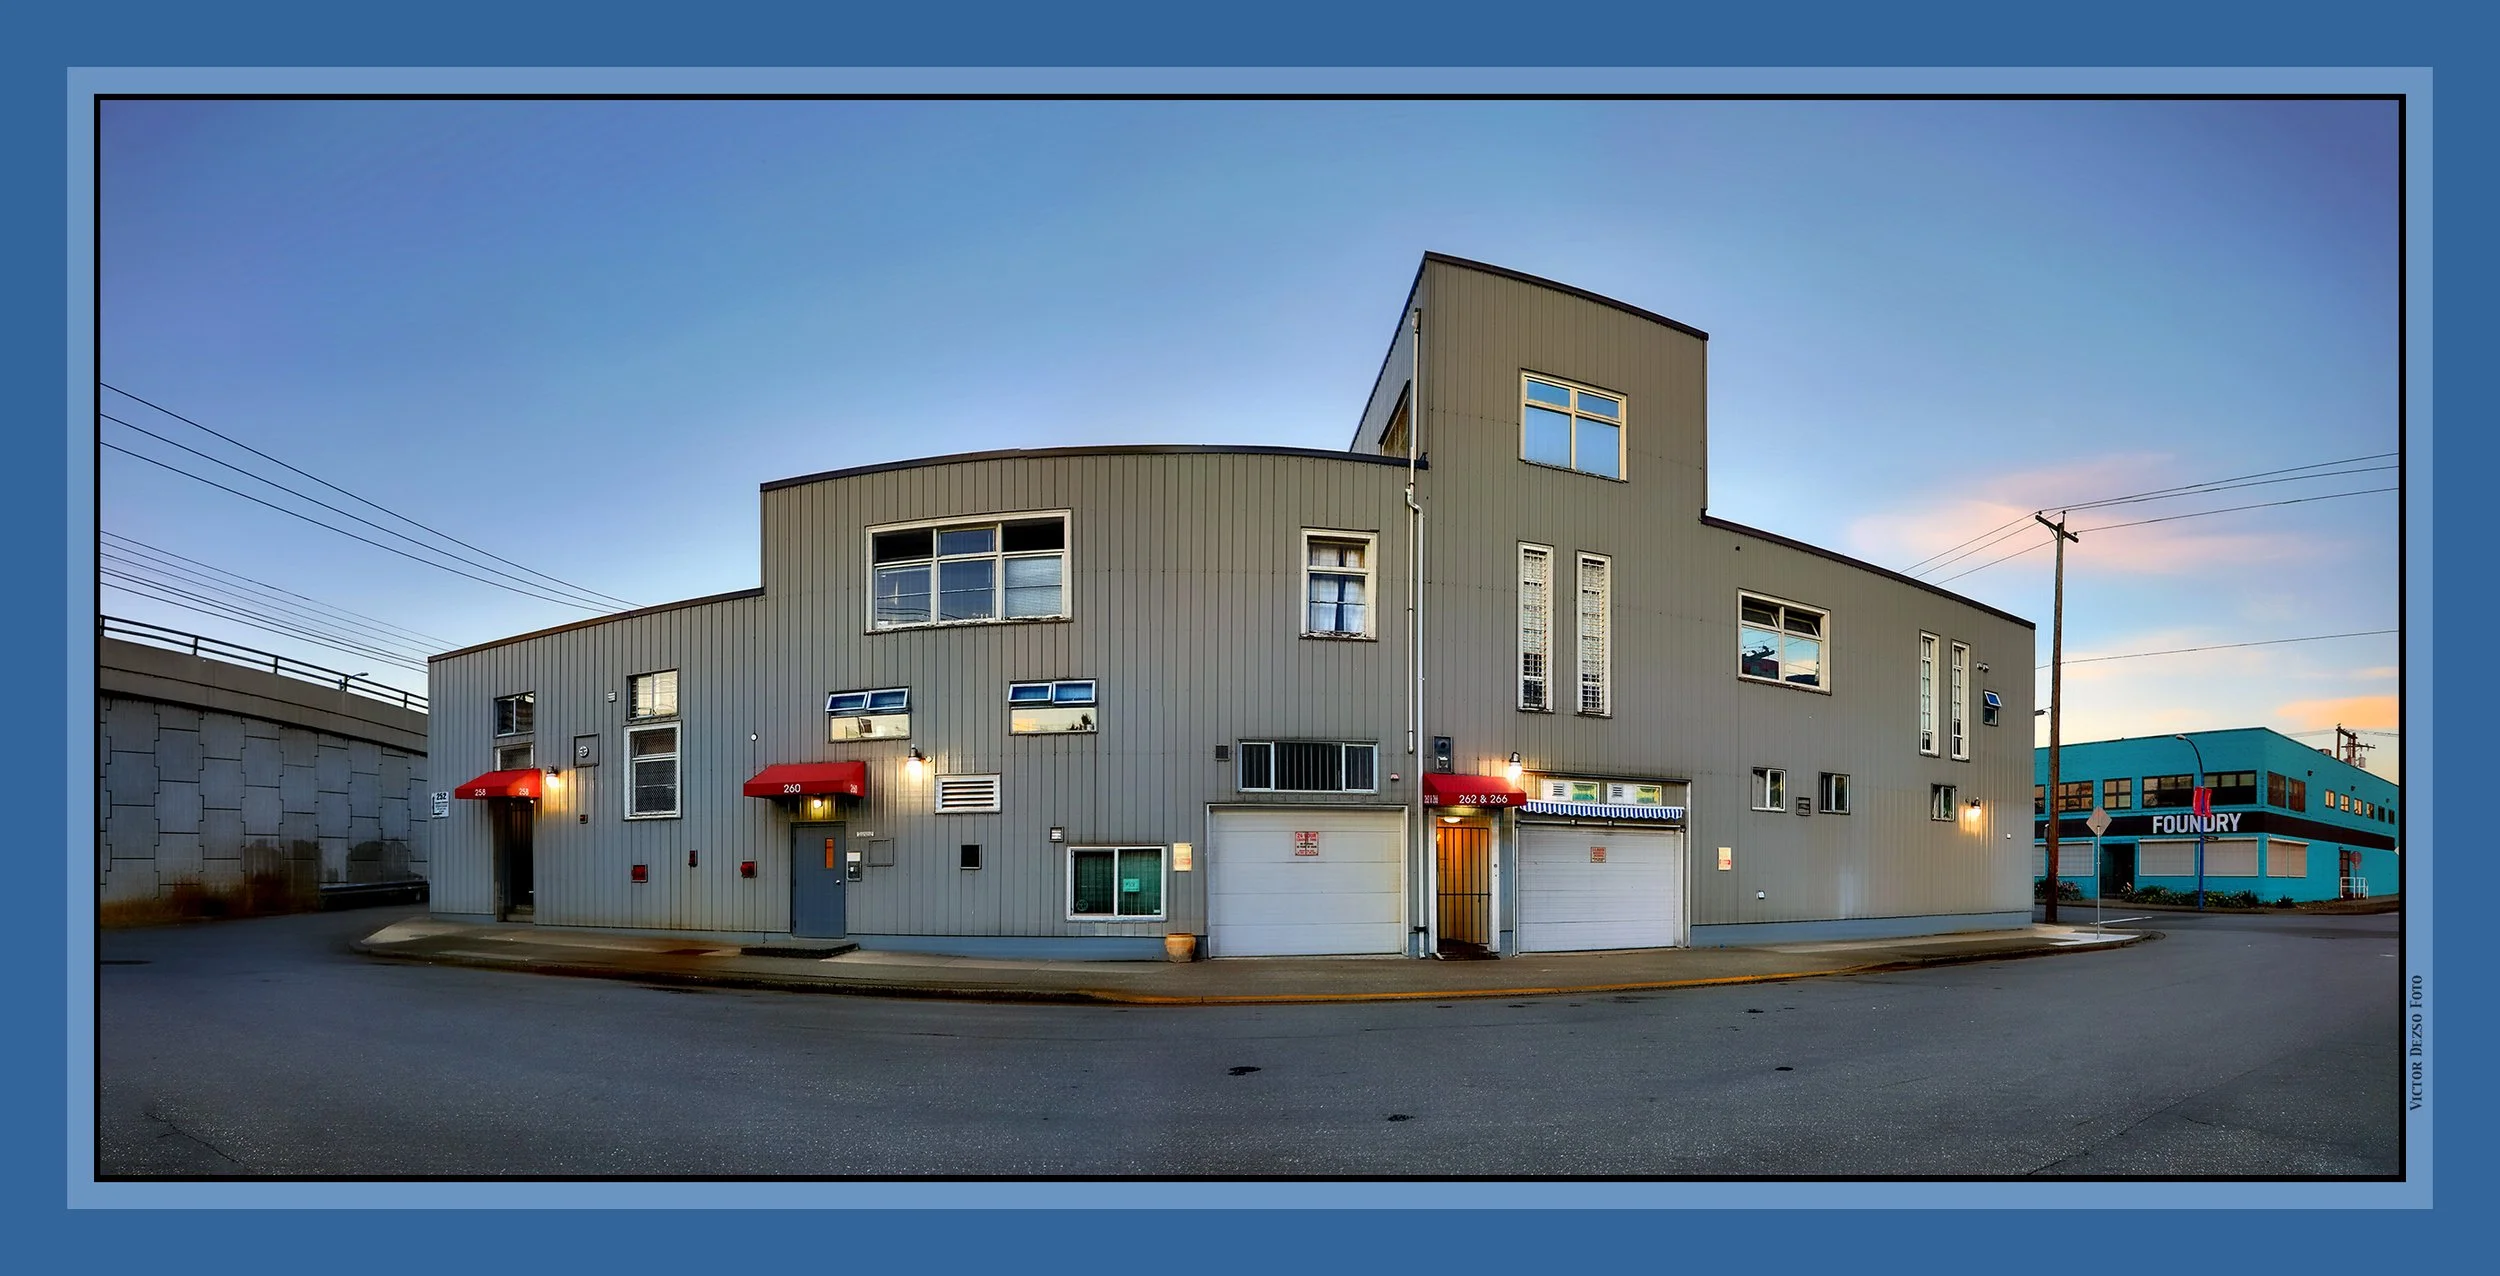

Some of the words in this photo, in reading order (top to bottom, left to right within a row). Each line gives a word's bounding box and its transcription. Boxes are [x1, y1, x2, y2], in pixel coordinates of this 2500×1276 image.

[519, 788, 530, 796] 258
[784, 784, 801, 793] 260
[1459, 794, 1477, 804] 262
[1480, 794, 1487, 804] &
[1490, 794, 1508, 804] 266
[2152, 813, 2242, 834] FOUNDRY
